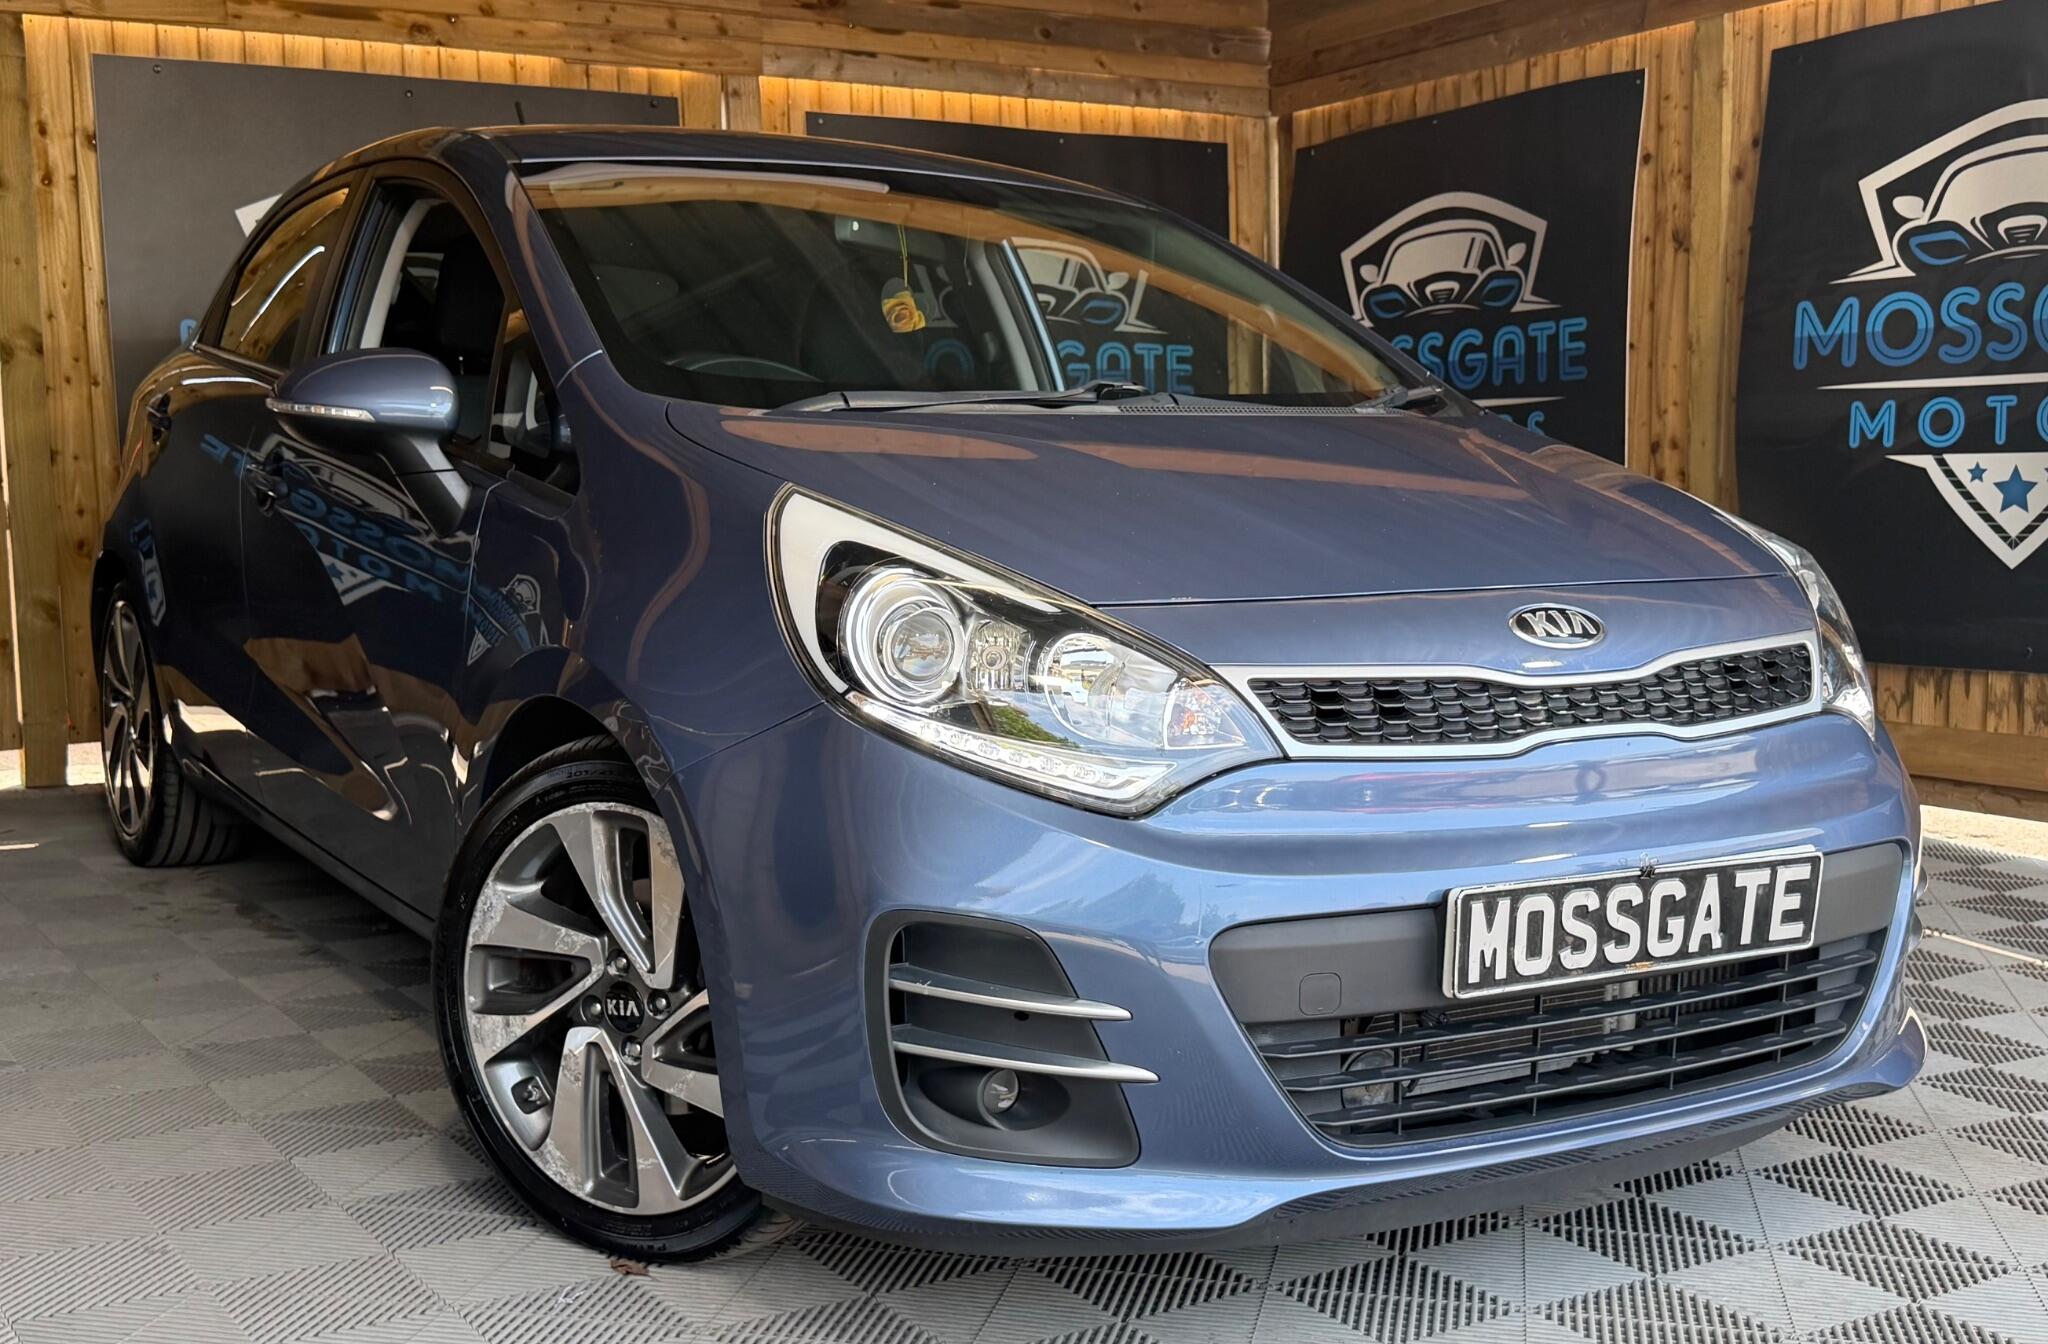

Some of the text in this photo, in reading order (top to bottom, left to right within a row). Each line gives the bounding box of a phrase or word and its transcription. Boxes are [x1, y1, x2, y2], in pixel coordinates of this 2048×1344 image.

[1793, 281, 2048, 371] MOSS
[1848, 394, 2048, 449] MOT
[1521, 610, 1597, 637] KIA
[1467, 863, 1812, 985] MOSSGATE
[606, 998, 640, 1017] KIA
